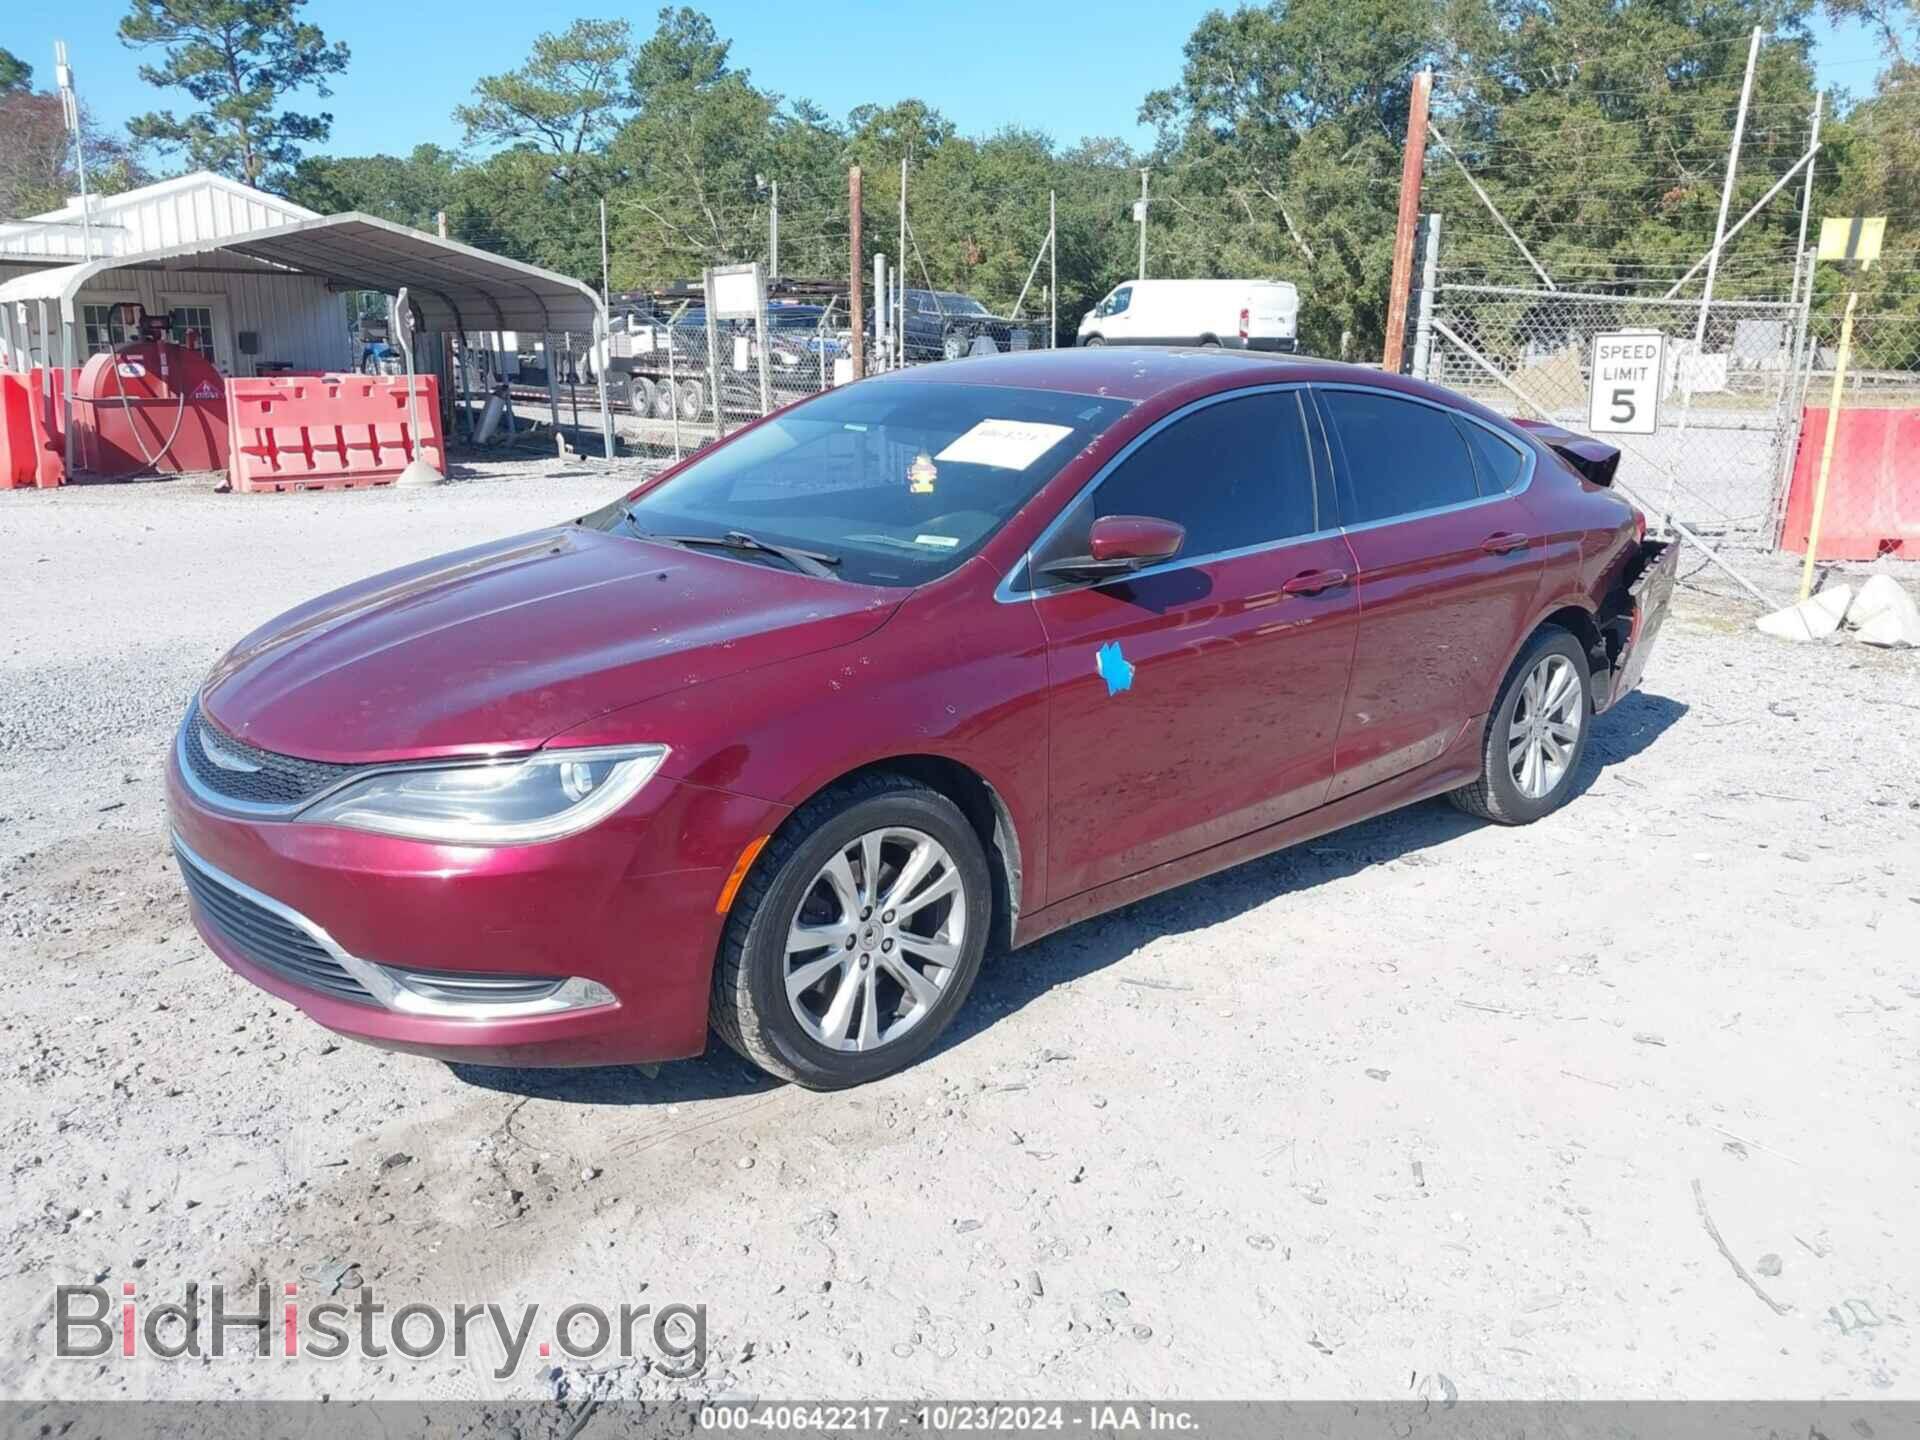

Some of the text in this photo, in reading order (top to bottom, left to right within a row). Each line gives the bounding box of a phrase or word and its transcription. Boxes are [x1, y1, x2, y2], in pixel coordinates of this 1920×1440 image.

[1600, 345, 1657, 360] SPEED
[1603, 366, 1648, 381] LIMIT
[1610, 388, 1636, 424] 5
